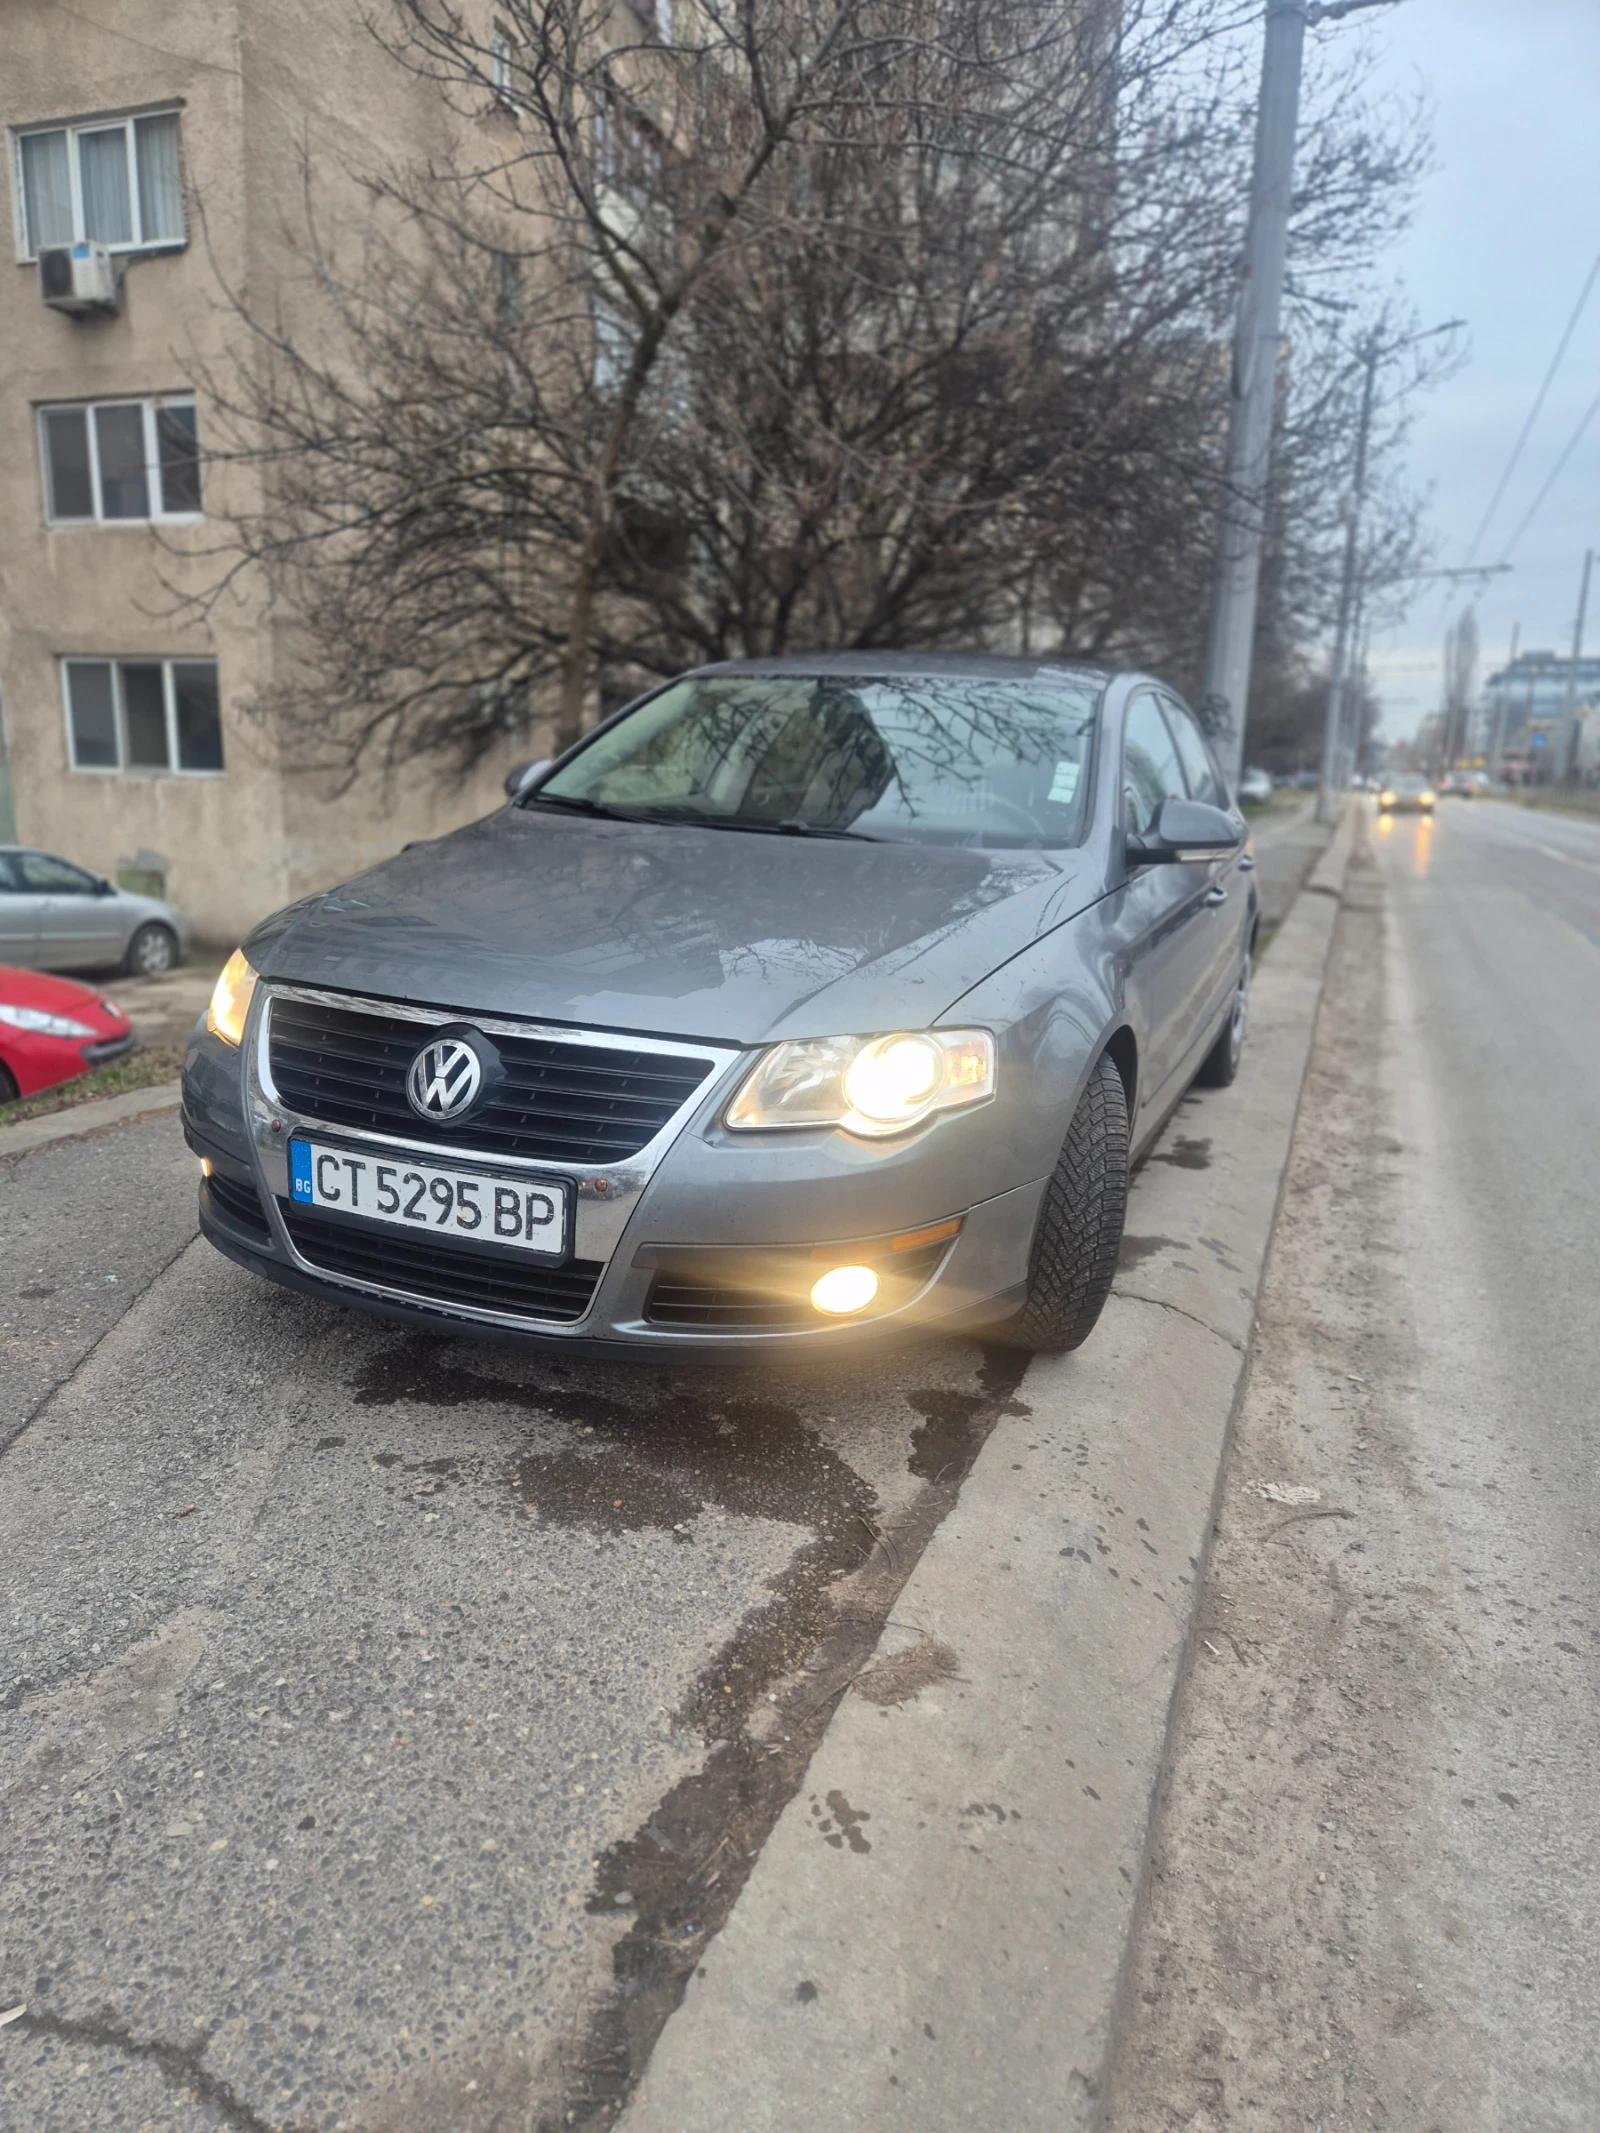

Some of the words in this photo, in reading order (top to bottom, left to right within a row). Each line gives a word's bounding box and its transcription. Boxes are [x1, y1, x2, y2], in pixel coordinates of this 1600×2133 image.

[409, 1040, 480, 1119] VW
[295, 1178, 311, 1194] BG
[316, 1154, 366, 1206] CT
[376, 1165, 482, 1230] 5295
[494, 1186, 555, 1240] BP
